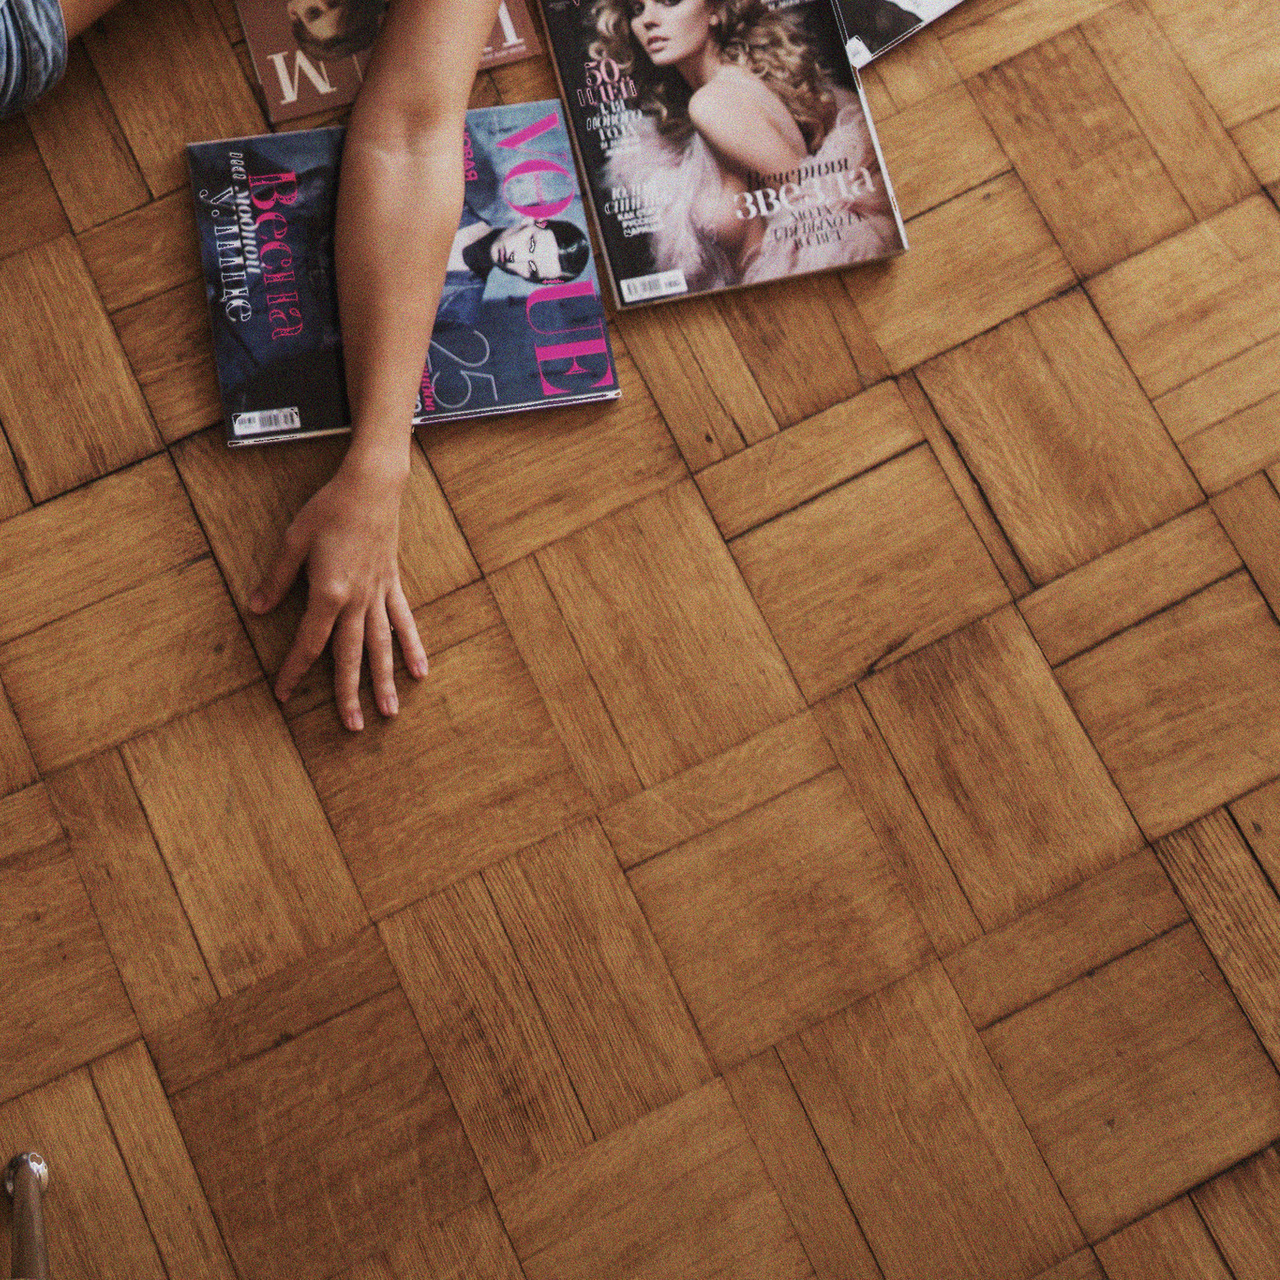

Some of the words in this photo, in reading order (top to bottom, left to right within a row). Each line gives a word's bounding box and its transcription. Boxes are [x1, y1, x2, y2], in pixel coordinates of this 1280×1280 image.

[583, 57, 621, 87] 50
[198, 186, 253, 323] улице
[233, 184, 265, 274] модной
[247, 169, 304, 341] Весна
[496, 107, 614, 396] VOUE
[426, 329, 498, 408] 25
